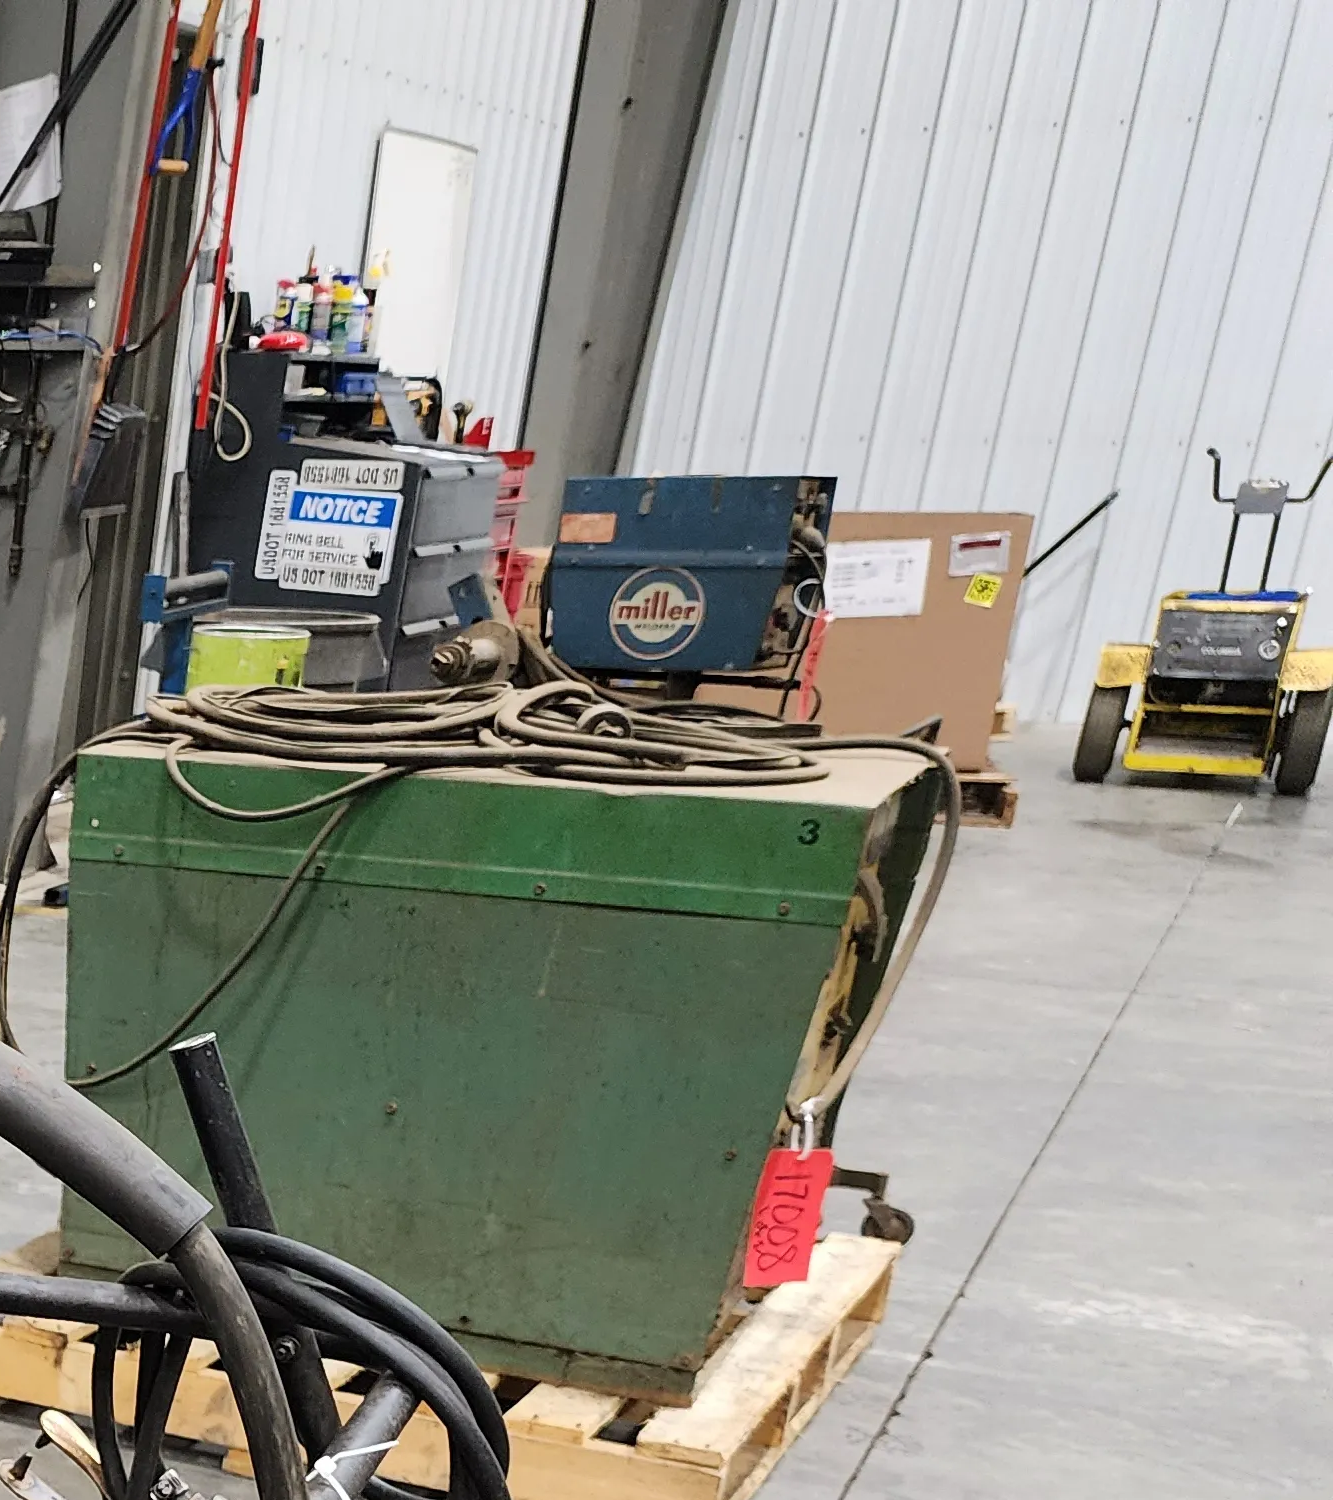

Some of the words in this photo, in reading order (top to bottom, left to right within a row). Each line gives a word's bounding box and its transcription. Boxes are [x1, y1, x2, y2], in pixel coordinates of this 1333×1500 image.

[383, 467, 399, 485] US
[298, 494, 385, 525] NOTICE
[284, 532, 313, 547] RING
[315, 536, 345, 550] BELL
[282, 547, 306, 562] FOR
[308, 550, 359, 567] SERVICE
[283, 566, 299, 583] US
[301, 568, 326, 586] DOT
[617, 590, 697, 621] miller
[796, 818, 821, 846] 3
